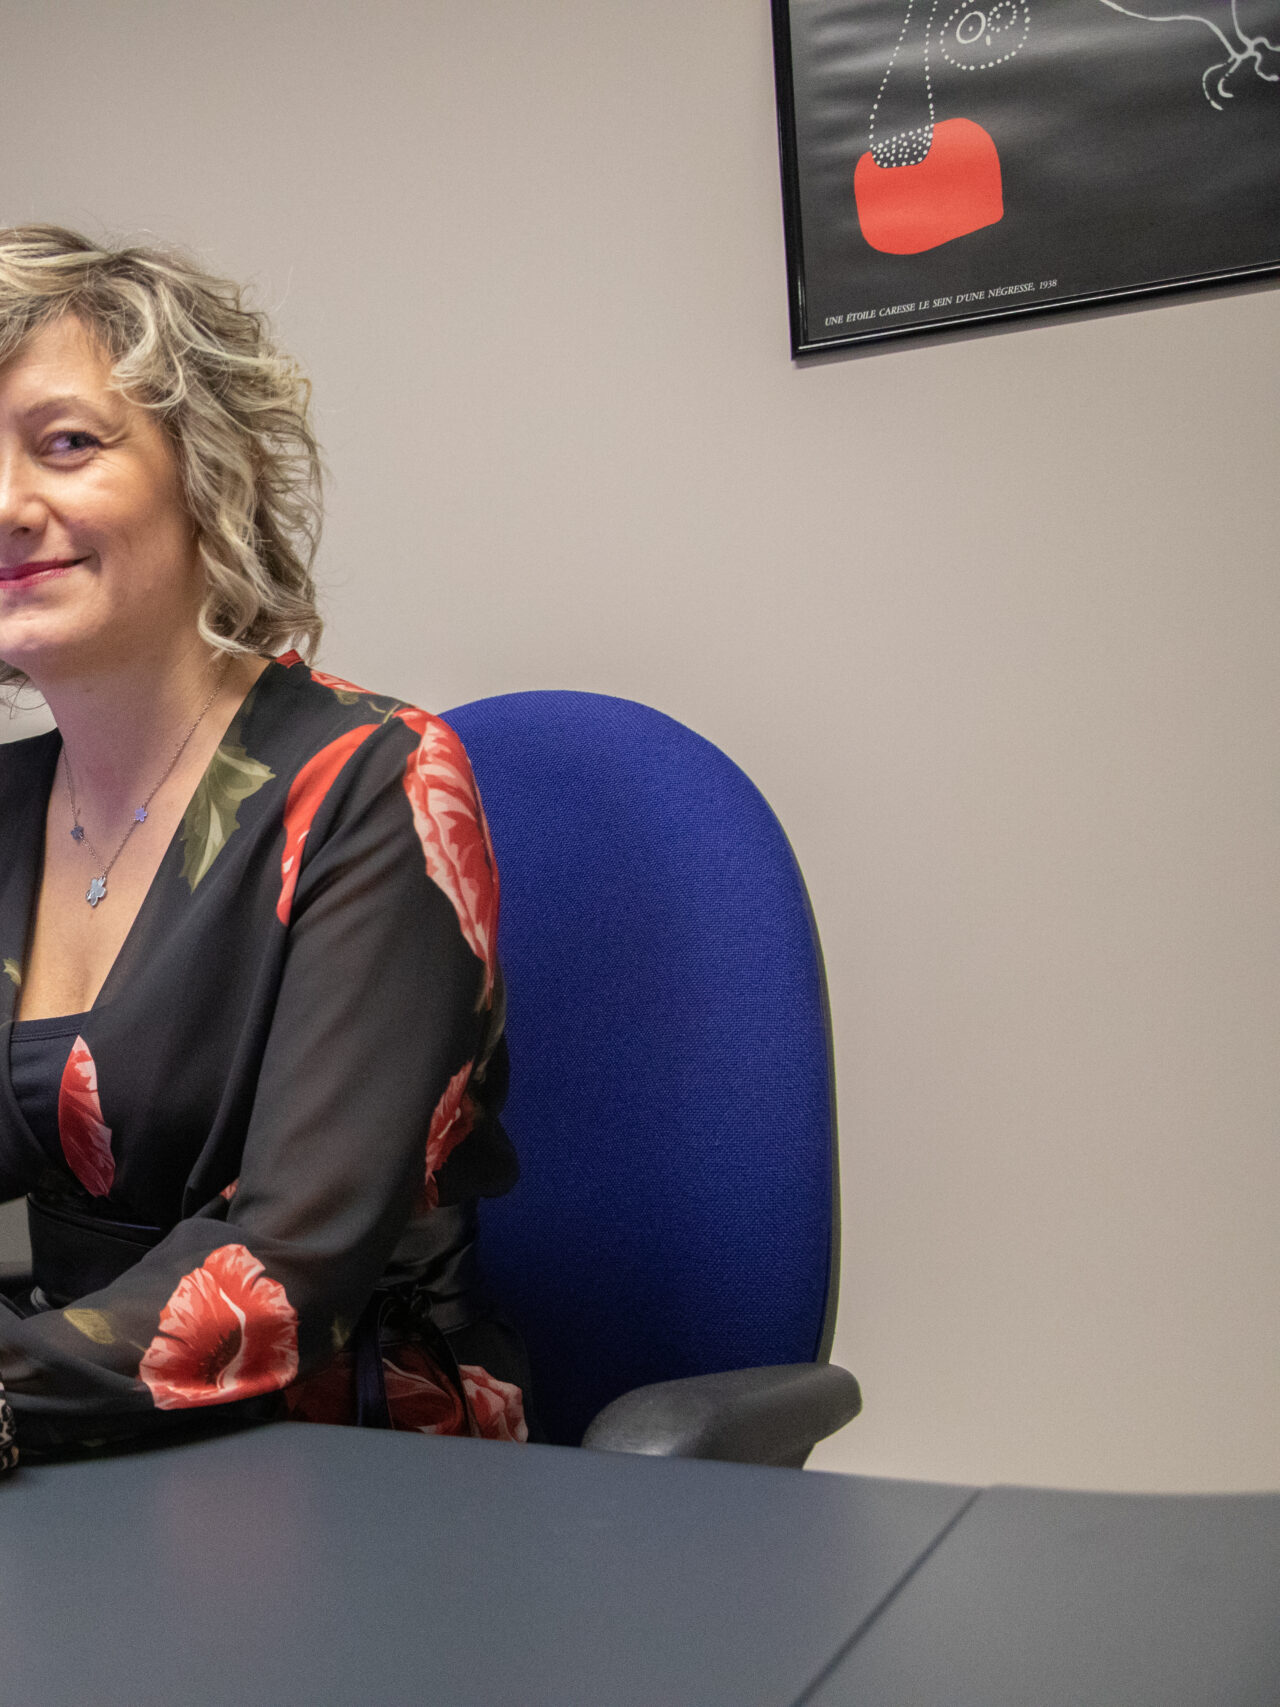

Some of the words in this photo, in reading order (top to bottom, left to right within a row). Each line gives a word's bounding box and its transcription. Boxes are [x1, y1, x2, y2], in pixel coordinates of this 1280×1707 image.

[824, 315, 844, 327] UNE
[846, 309, 876, 323] ÉTOILE
[878, 302, 916, 318] CARESSE
[918, 300, 930, 311] LE
[932, 297, 953, 308] SEIN
[955, 291, 985, 304] D'UNE
[1038, 279, 1058, 290] 1938
